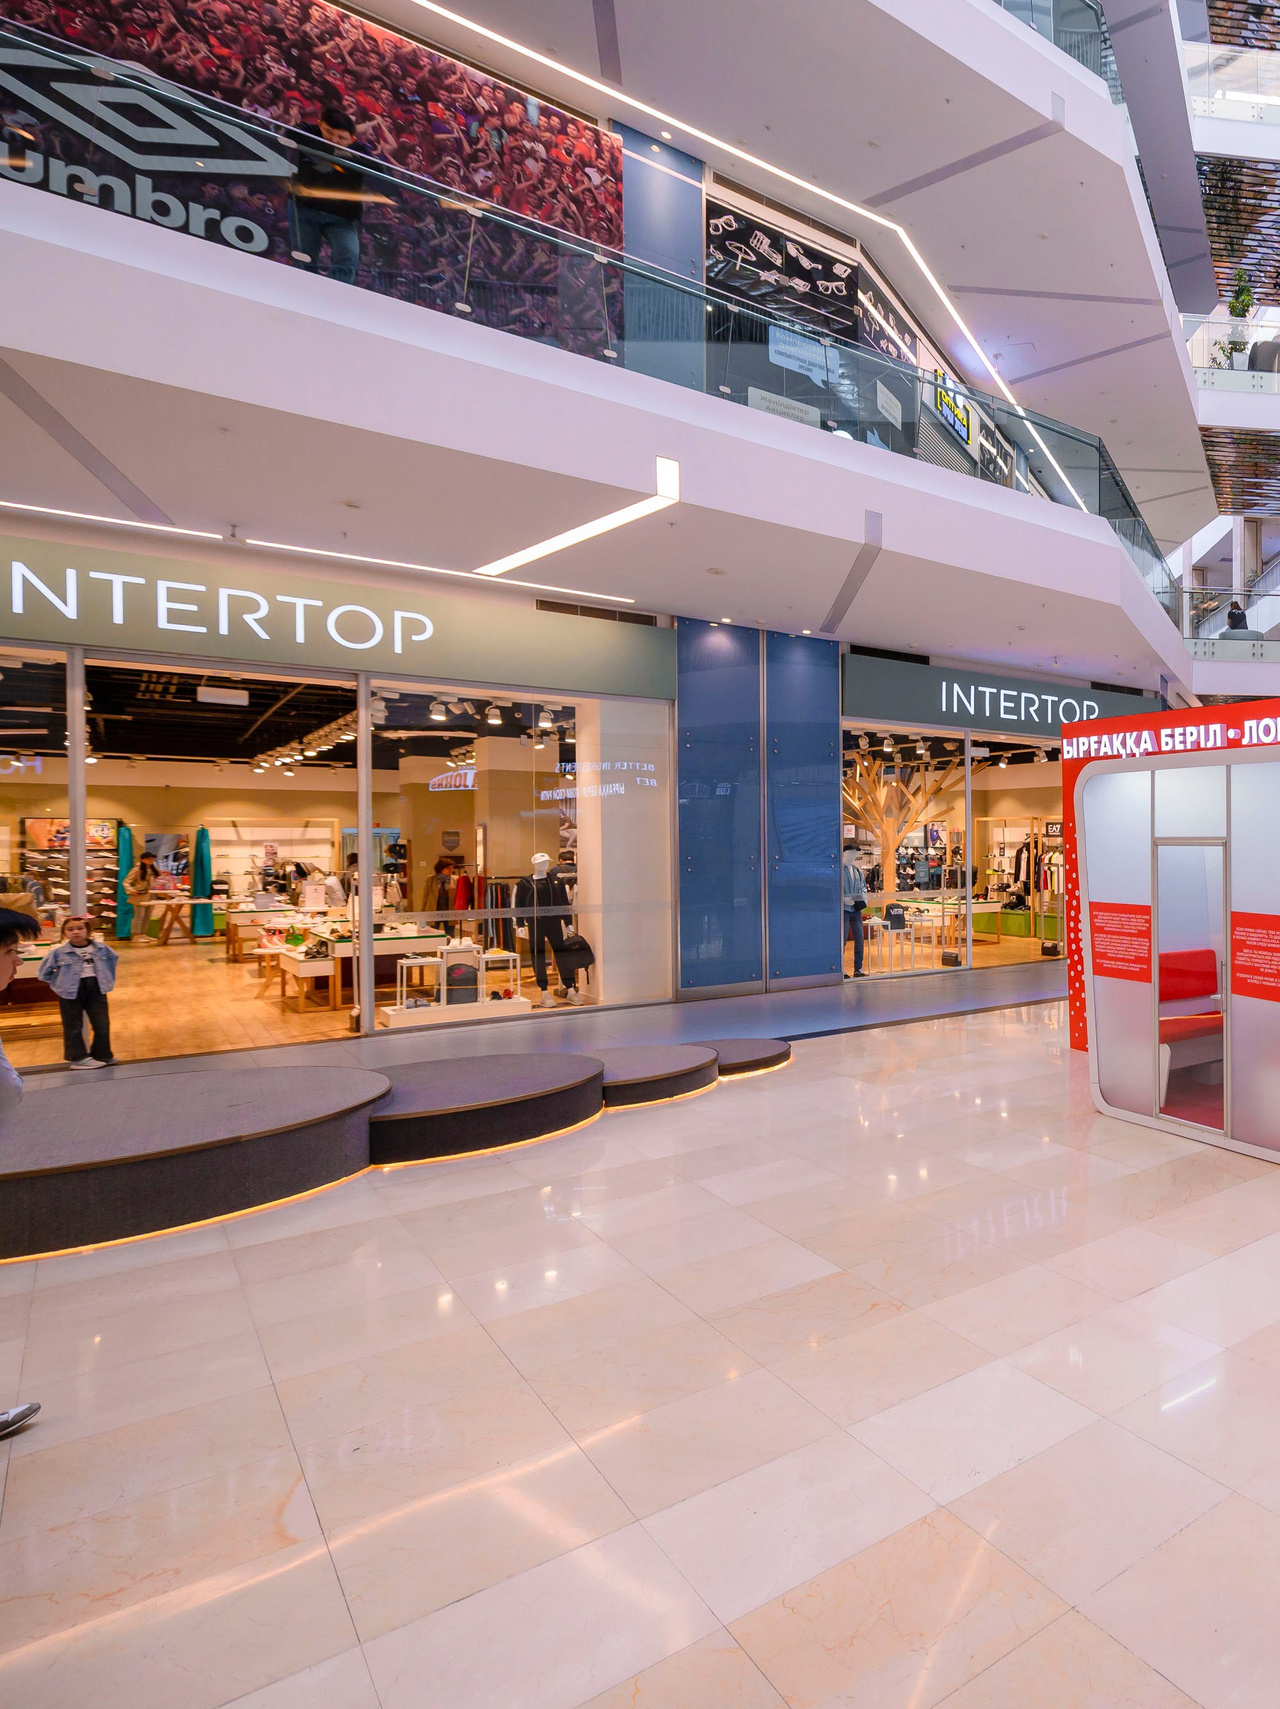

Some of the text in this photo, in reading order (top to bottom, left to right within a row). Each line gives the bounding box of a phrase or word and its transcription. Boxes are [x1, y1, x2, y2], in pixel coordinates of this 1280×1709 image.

[0, 140, 269, 252] umbro
[12, 561, 434, 654] NTERTOP
[941, 681, 1099, 724] INTERTOP
[1160, 724, 1227, 752] БЕРІЛ
[1048, 825, 1061, 833] EA7
